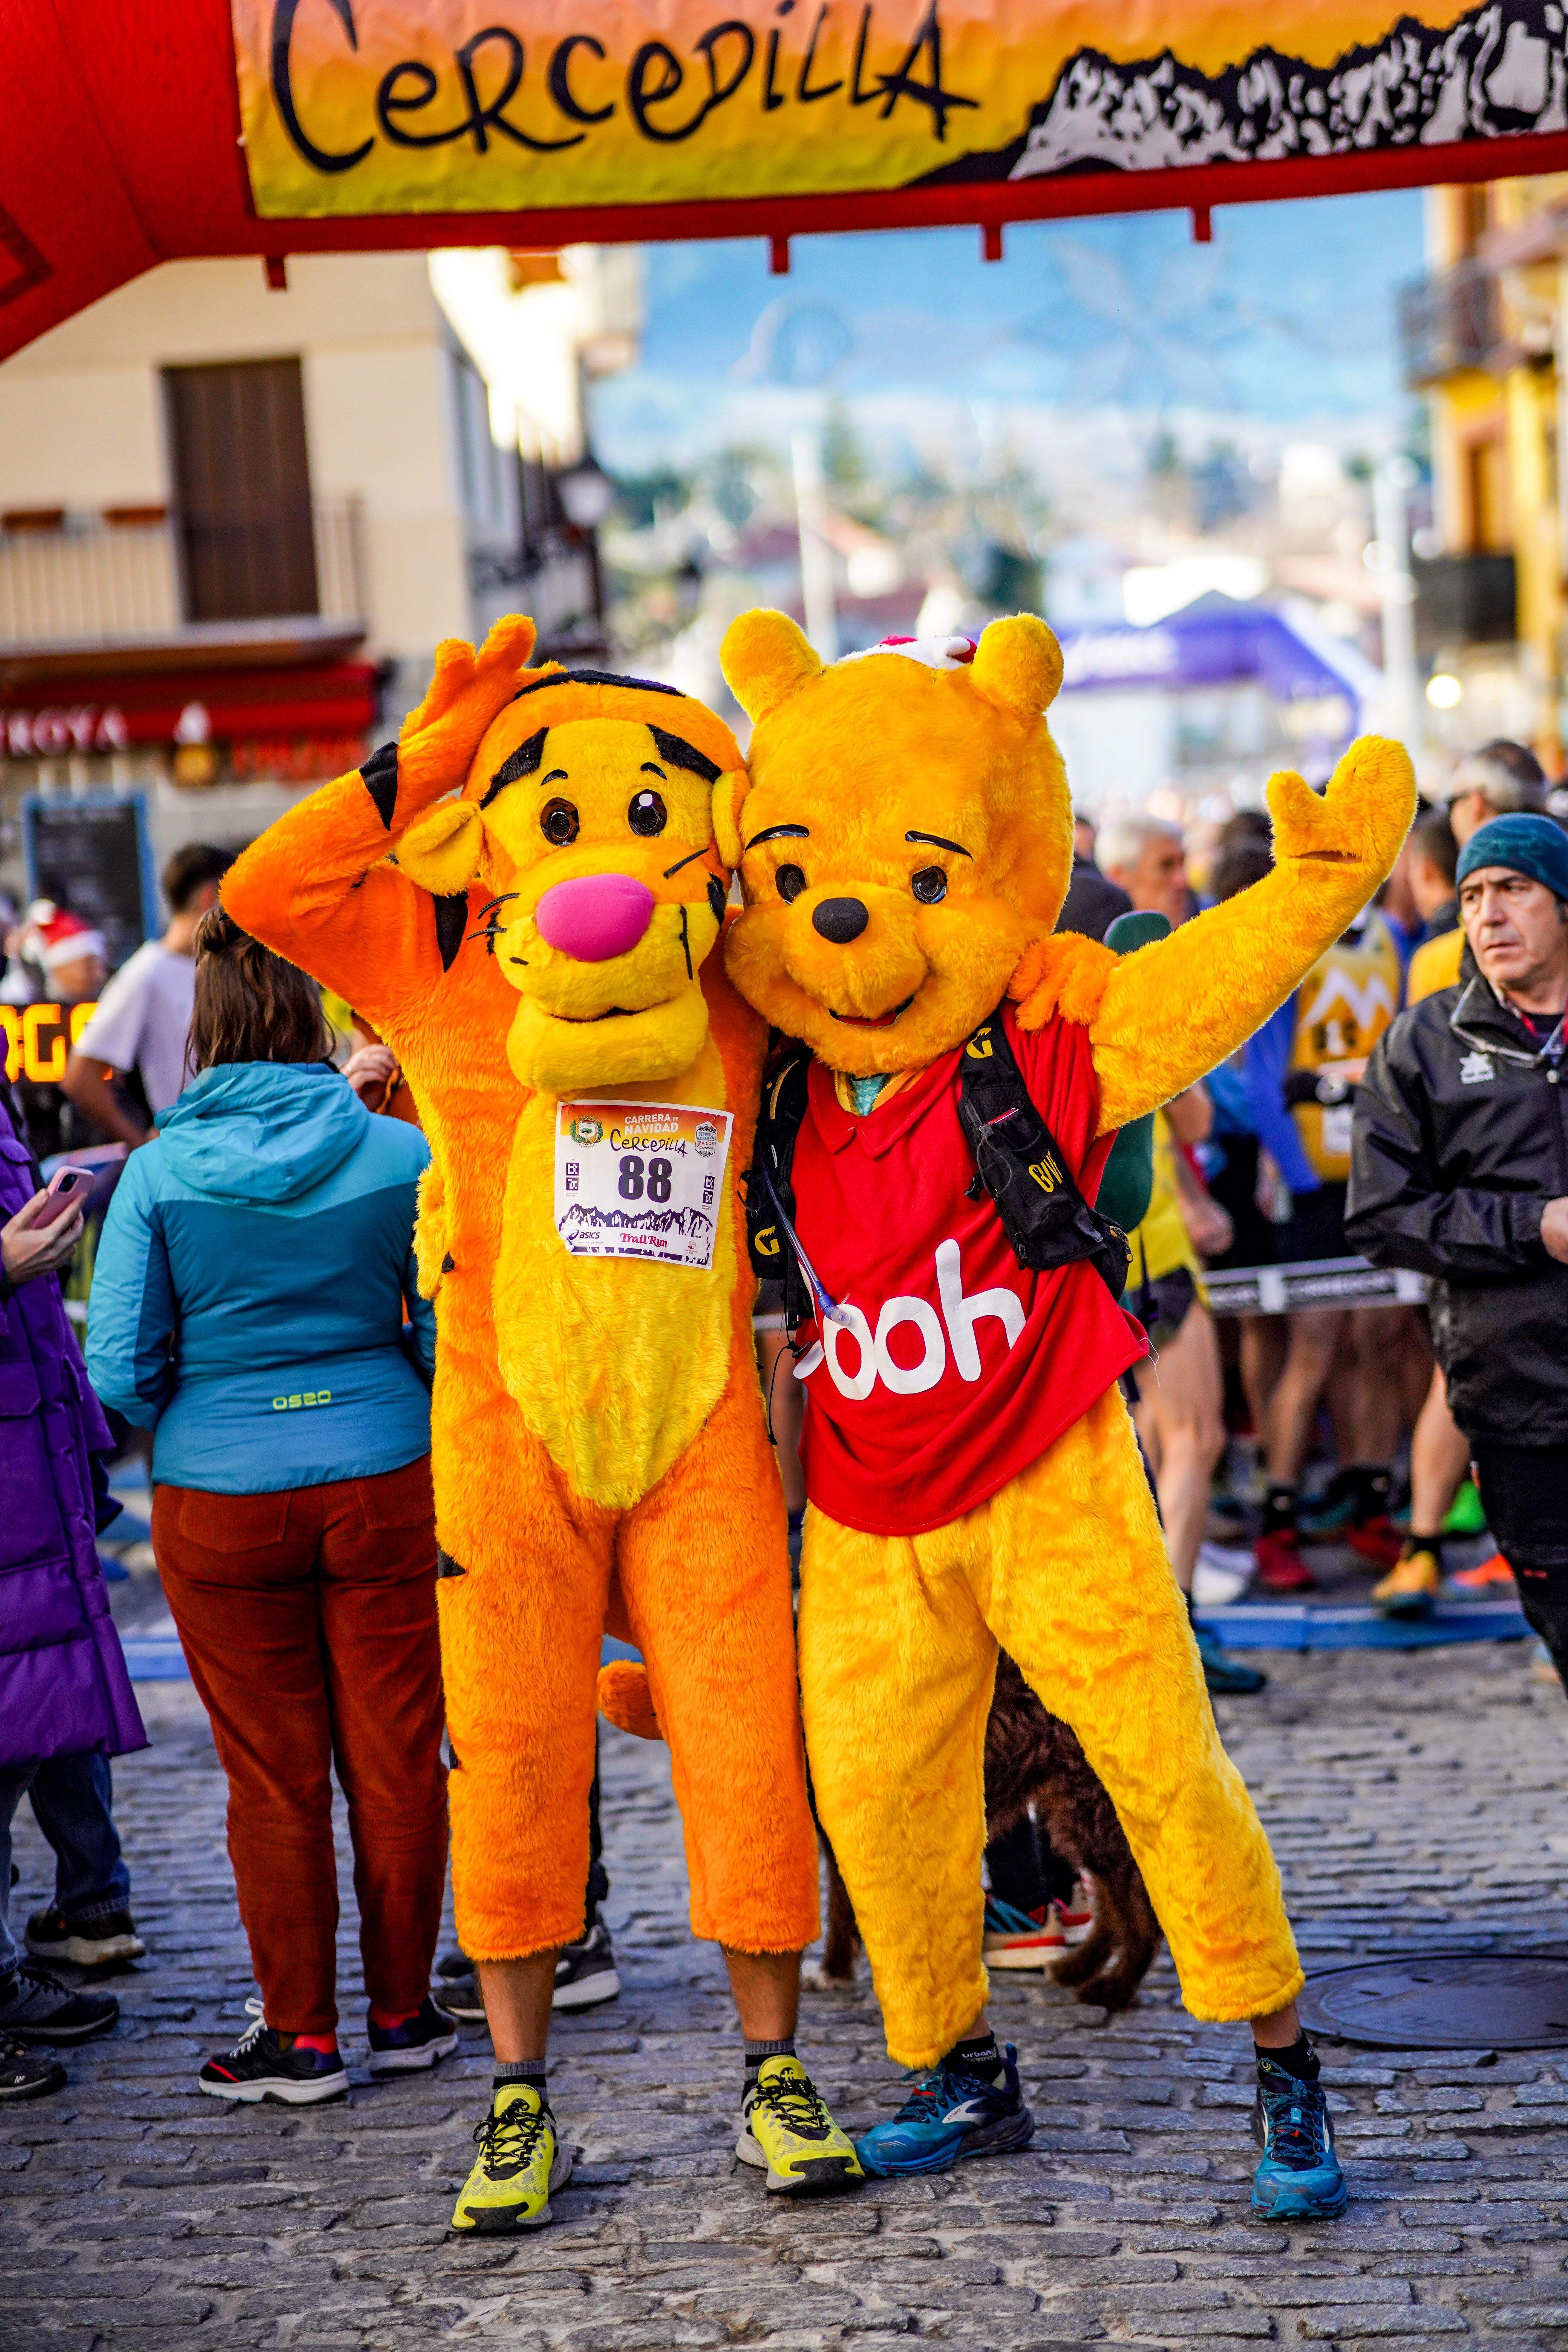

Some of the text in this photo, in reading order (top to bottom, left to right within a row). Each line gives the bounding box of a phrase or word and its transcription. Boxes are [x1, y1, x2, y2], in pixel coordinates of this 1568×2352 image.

[624, 1122, 678, 1135] NAVIDAD
[625, 1113, 671, 1124] CARRERA
[618, 1155, 672, 1203] 88
[793, 1239, 1026, 1401] ooh
